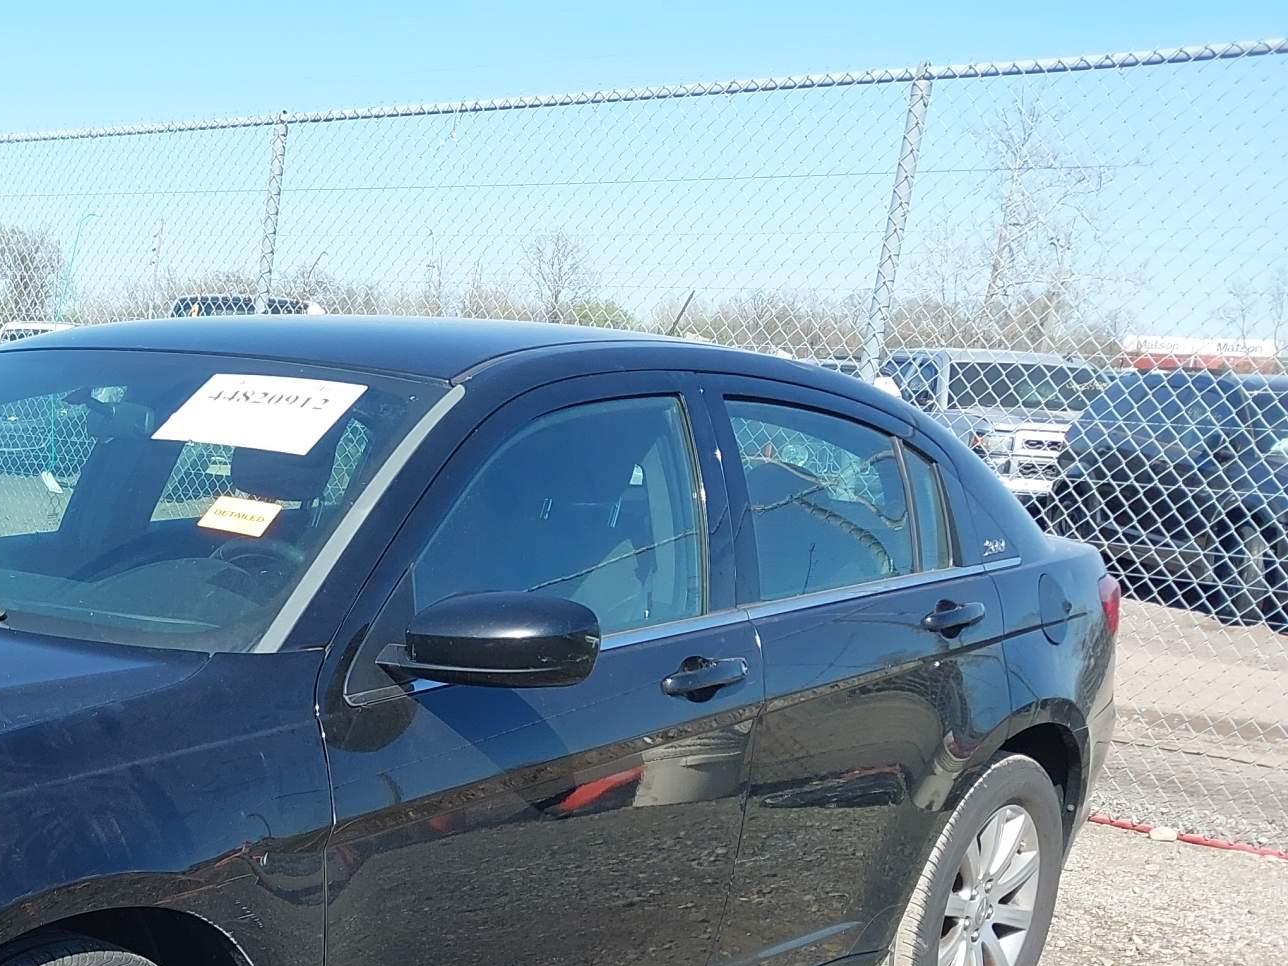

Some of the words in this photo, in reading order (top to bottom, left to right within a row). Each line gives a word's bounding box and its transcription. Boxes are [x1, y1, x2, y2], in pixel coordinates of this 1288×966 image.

[1137, 339, 1180, 351] Matson
[1216, 342, 1264, 354] Matson
[208, 390, 330, 409] 44820912
[214, 508, 265, 523] DETAILED
